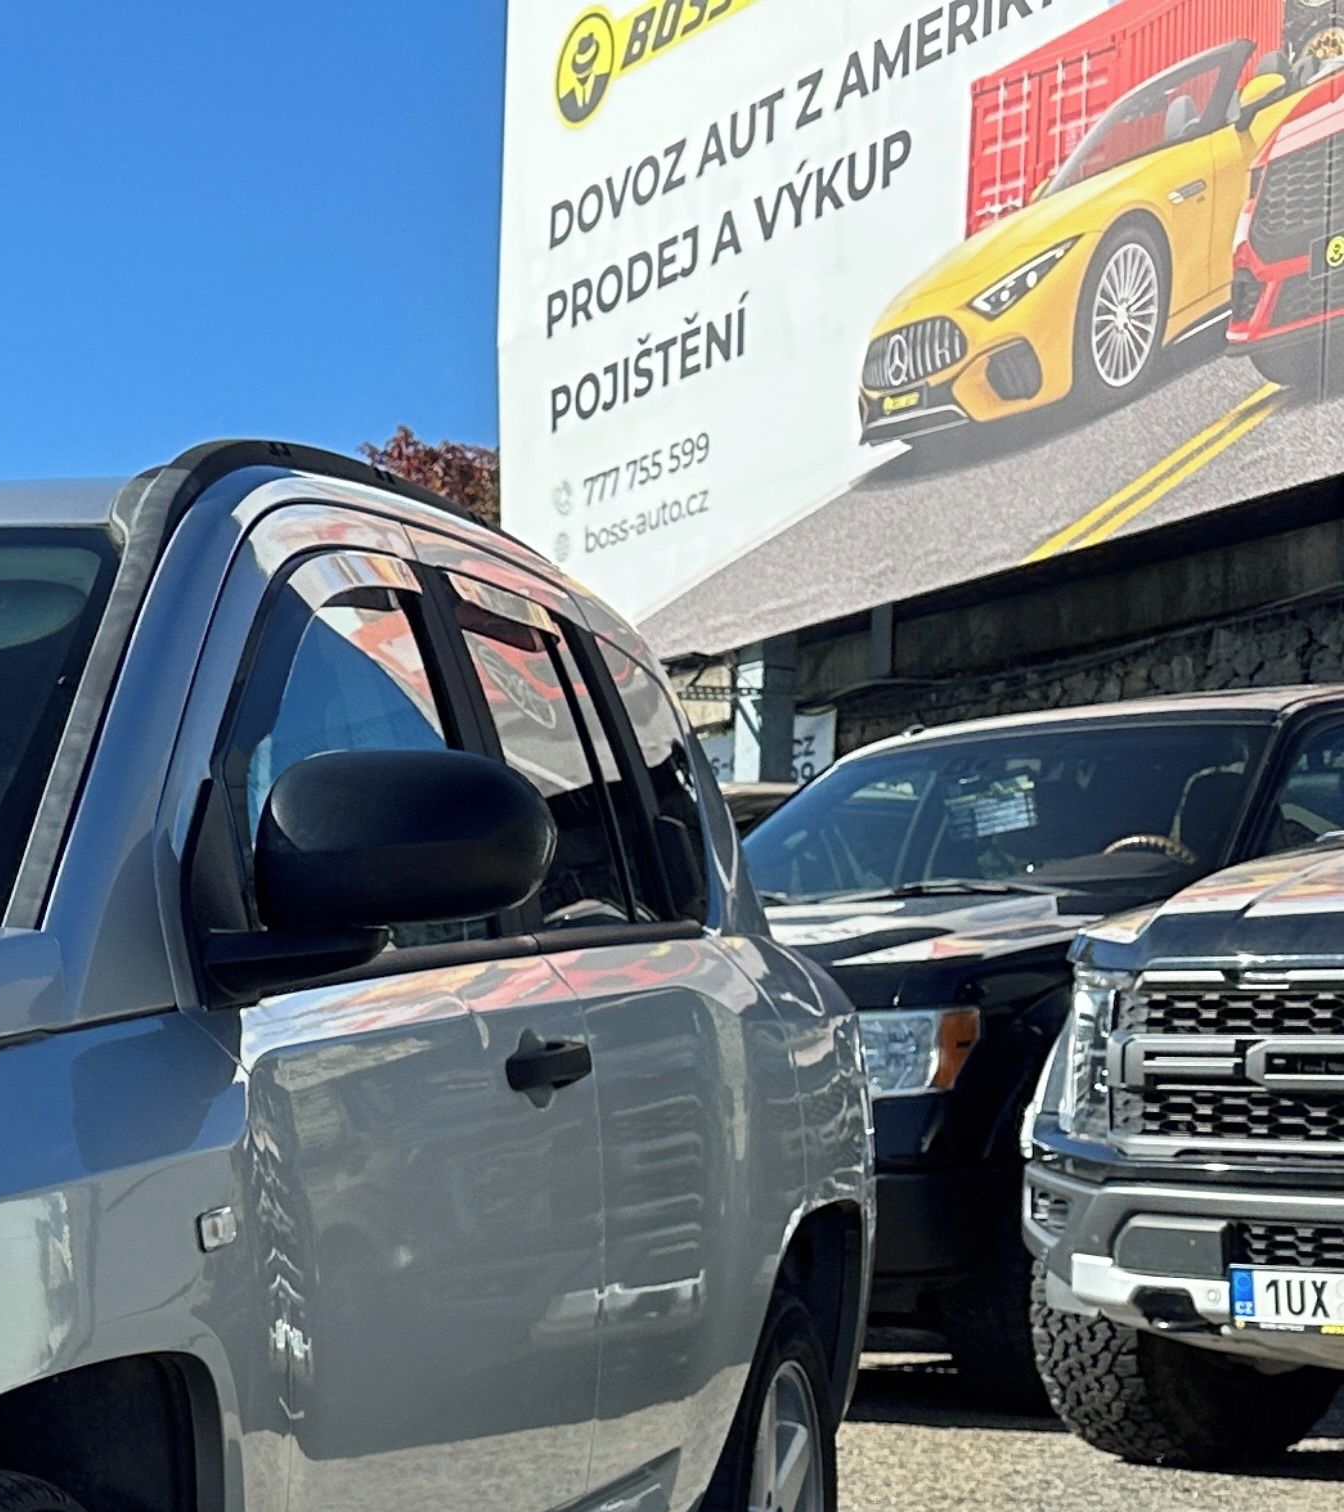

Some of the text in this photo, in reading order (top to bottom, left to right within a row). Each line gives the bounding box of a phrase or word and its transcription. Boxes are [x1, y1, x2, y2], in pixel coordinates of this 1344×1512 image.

[549, 0, 1052, 249] DOVOZ AUT Z AMERIK
[546, 129, 912, 339] PRODEJ A VÝKUP
[550, 290, 750, 434] POJIŠTĚNÍ
[583, 432, 710, 506] 777 755 599
[584, 489, 710, 553] boss-auto.cz
[1235, 1301, 1254, 1315] CZ
[1265, 1279, 1330, 1318] 1UX
